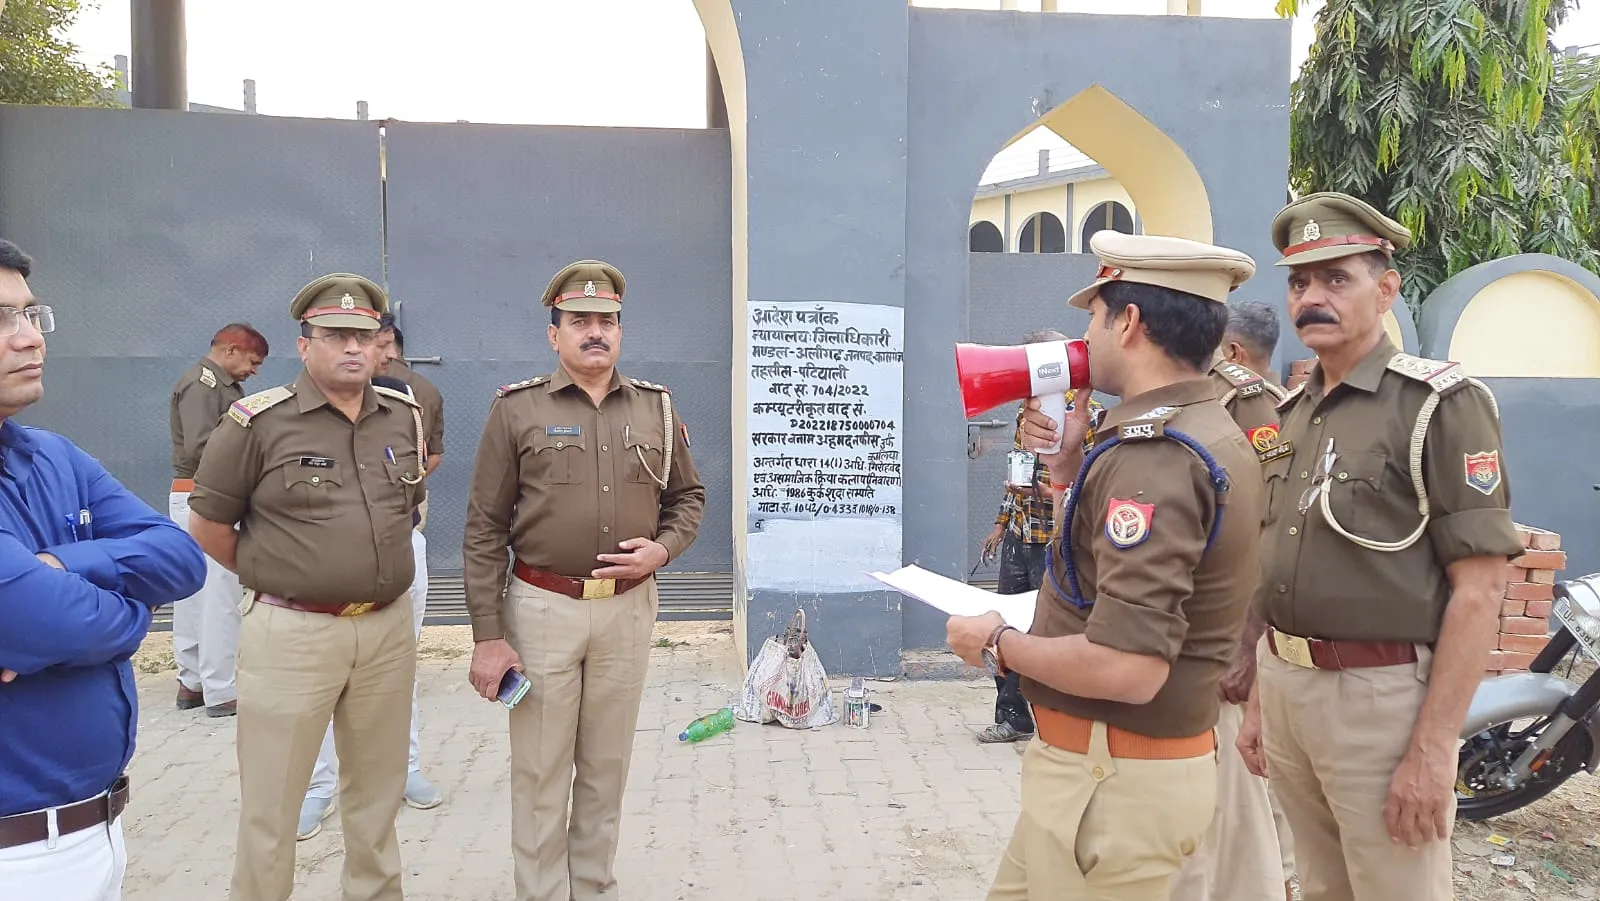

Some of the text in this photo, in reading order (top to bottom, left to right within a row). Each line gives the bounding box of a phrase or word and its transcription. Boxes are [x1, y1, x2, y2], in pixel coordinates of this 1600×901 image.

[752, 306, 793, 327] आदेश
[769, 383, 792, 398] वाद
[812, 384, 869, 397] 704/2022
[827, 402, 851, 418] वाद
[790, 419, 895, 431] D202218750000704
[751, 432, 788, 447] सरकार
[816, 434, 853, 449] अहमद
[795, 456, 817, 469] धारा
[786, 487, 806, 499] 1986
[758, 502, 780, 513] गाटा
